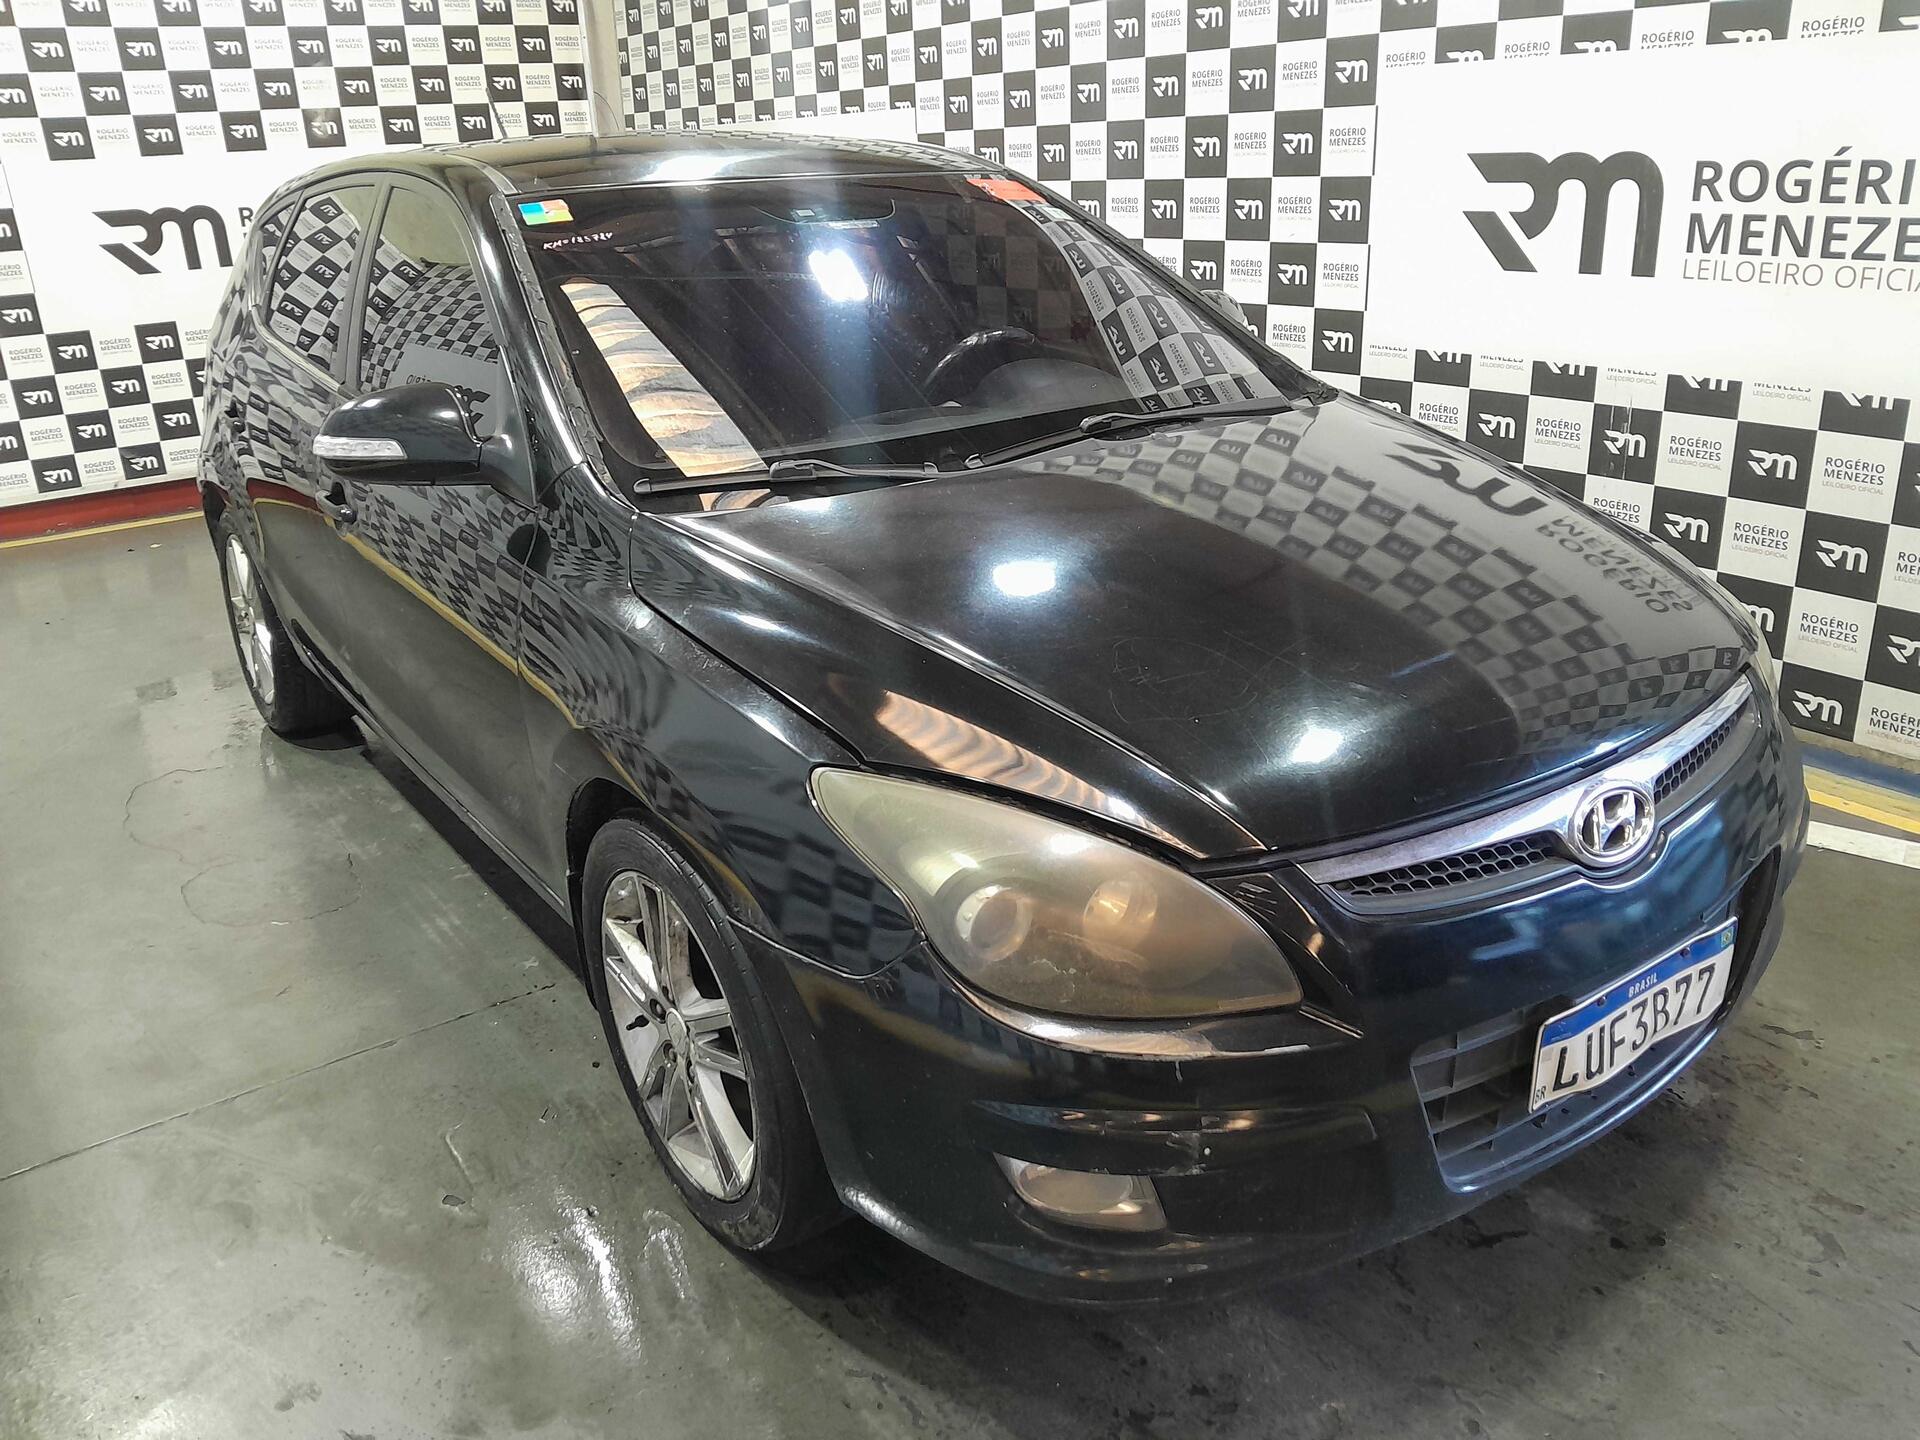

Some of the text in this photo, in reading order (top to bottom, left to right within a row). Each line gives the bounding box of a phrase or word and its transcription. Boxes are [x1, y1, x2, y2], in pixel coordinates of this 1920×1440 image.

[1237, 6, 1271, 18] MENEZES
[1151, 17, 1180, 28] MENEZES
[1802, 16, 1865, 32] ROGÉRIO
[1074, 28, 1101, 38] MENEZES
[1641, 30, 1694, 44] ROGÉRIO
[1505, 40, 1550, 54] ROGÉRIO
[1386, 50, 1426, 62] ROGÉRIO
[1282, 70, 1317, 80] MENEZES
[1191, 78, 1222, 87] MENEZES
[1111, 85, 1139, 94] MENEZES
[1234, 141, 1266, 149] MENEZES
[1329, 136, 1366, 146] MENEZES
[1075, 147, 1101, 155] MENEZES
[1150, 144, 1179, 152] MENEZES
[1189, 205, 1220, 213] MENEZES
[1277, 205, 1311, 214] MENEZES
[1230, 268, 1262, 276] MENEZES
[1323, 272, 1358, 281] MENEZES
[1682, 258, 1824, 286] LEILOEIRO
[1272, 332, 1305, 342] MENEZES
[1419, 403, 1459, 415] ROGÉRIO
[1418, 412, 1459, 424] MENEZES
[1536, 417, 1581, 431] ROGÉRIO
[1535, 427, 1580, 441] MENEZES
[1669, 435, 1722, 451] ROGÉRIO
[1668, 446, 1721, 461] MENEZES
[1824, 456, 1885, 474] ROGÉRIO
[1823, 468, 1884, 485] MENEZES
[1594, 498, 1640, 512] ROGÉRIO
[1734, 522, 1789, 540] ROGÉRIO
[1733, 532, 1788, 550] MENEZES
[1800, 612, 1859, 632] ROGÉRIO
[1799, 623, 1857, 643] MENEZES
[1628, 972, 1658, 998] BRASIL
[1552, 963, 1716, 1092] LUF3B77
